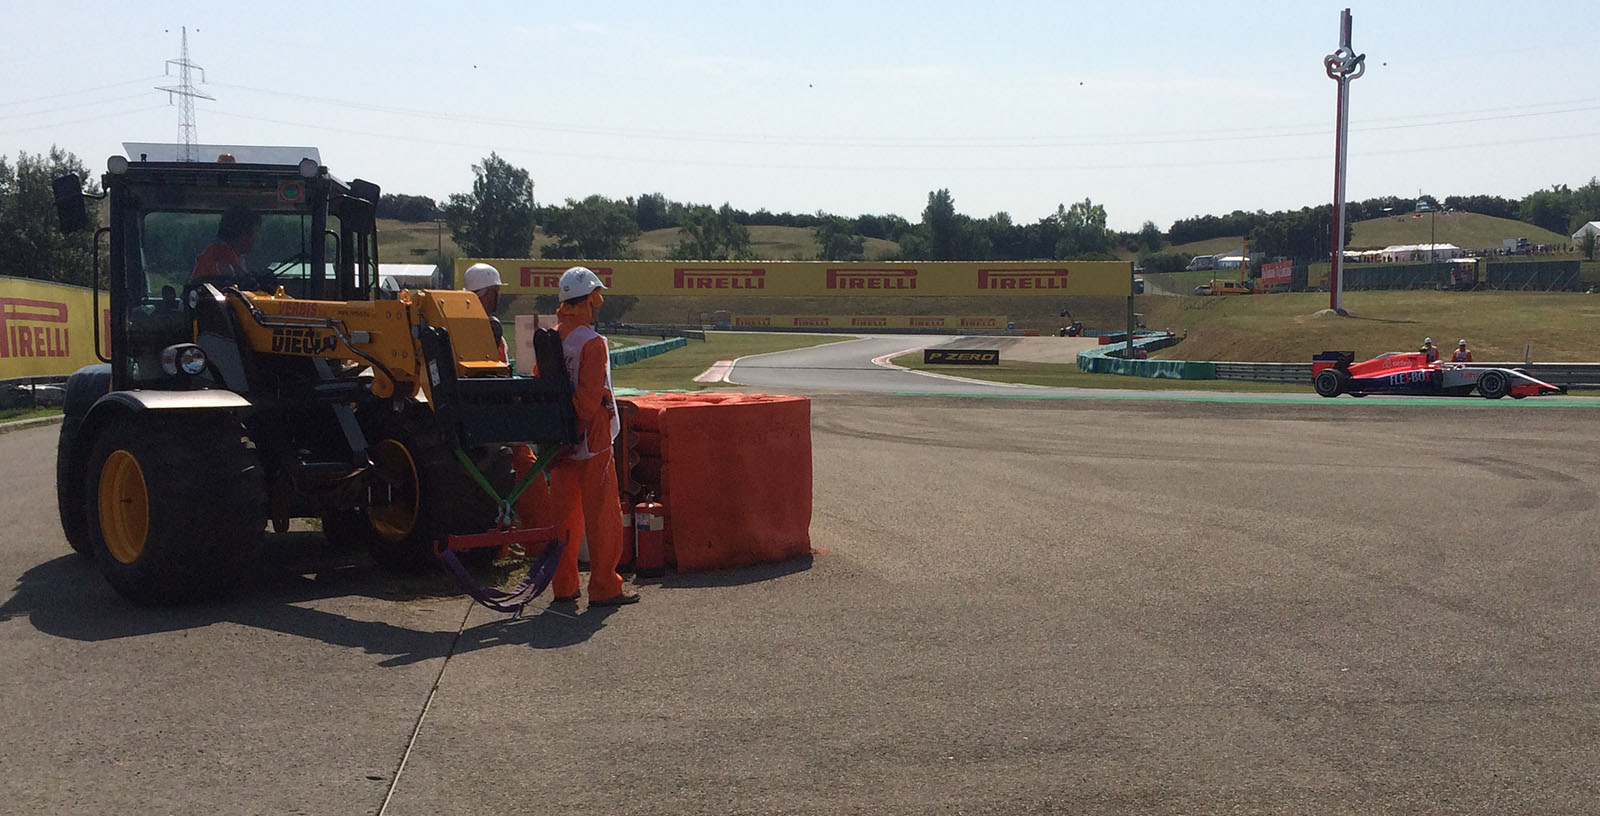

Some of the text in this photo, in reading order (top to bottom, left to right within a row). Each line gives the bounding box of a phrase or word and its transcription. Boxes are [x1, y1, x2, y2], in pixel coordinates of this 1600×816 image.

[520, 267, 613, 288] PIRI
[674, 268, 766, 289] PIRELLI
[826, 269, 918, 289] PIRELLI
[978, 269, 1069, 289] PIRELLI
[736, 317, 771, 326] PIRELLI
[794, 317, 829, 326] PIRELLI
[852, 317, 887, 326] PIRELLI
[910, 317, 945, 326] PIRELLI
[960, 317, 996, 326] PIRELLI
[0, 297, 70, 358] PIRELLI
[929, 352, 995, 361] P ZERO
